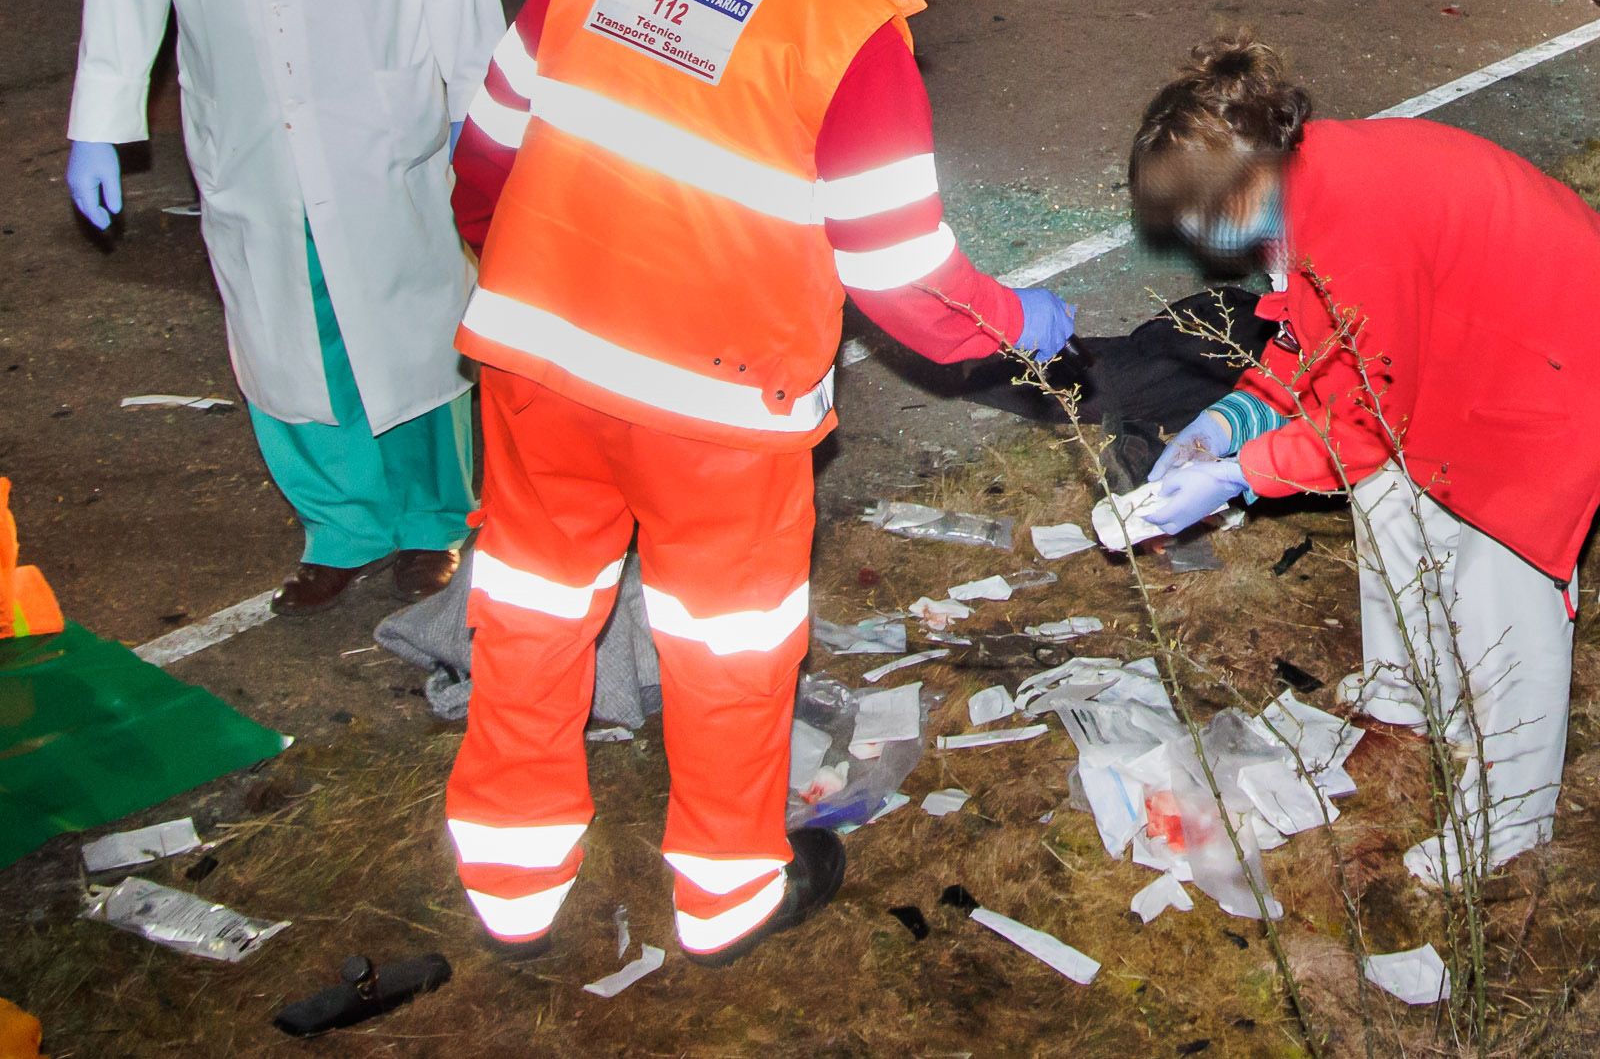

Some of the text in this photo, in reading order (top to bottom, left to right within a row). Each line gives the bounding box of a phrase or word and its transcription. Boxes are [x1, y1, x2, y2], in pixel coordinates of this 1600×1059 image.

[595, 11, 717, 72] Transporte Sanitario
[635, 15, 682, 43] Técnico
